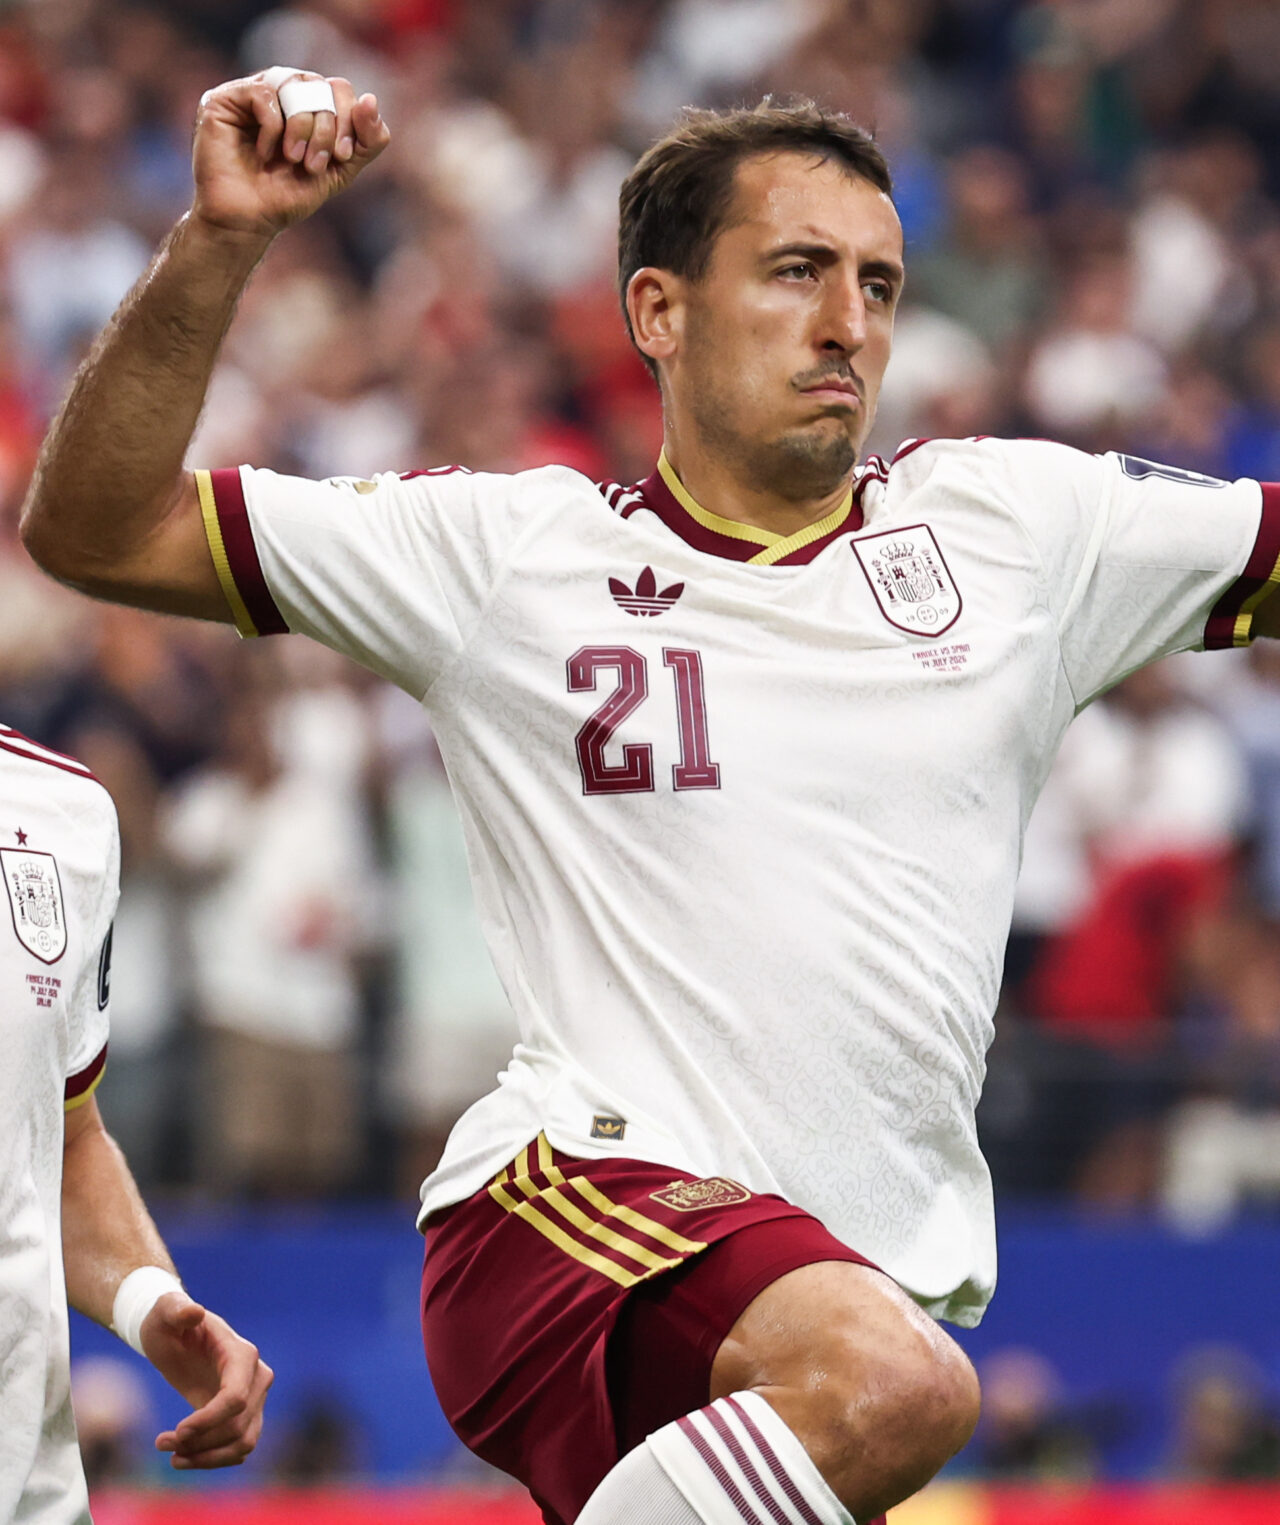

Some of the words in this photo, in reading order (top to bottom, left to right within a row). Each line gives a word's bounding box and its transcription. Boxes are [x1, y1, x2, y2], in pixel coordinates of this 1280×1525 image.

[932, 657, 947, 667] JULY
[949, 655, 967, 665] 2026
[566, 645, 722, 796] 21
